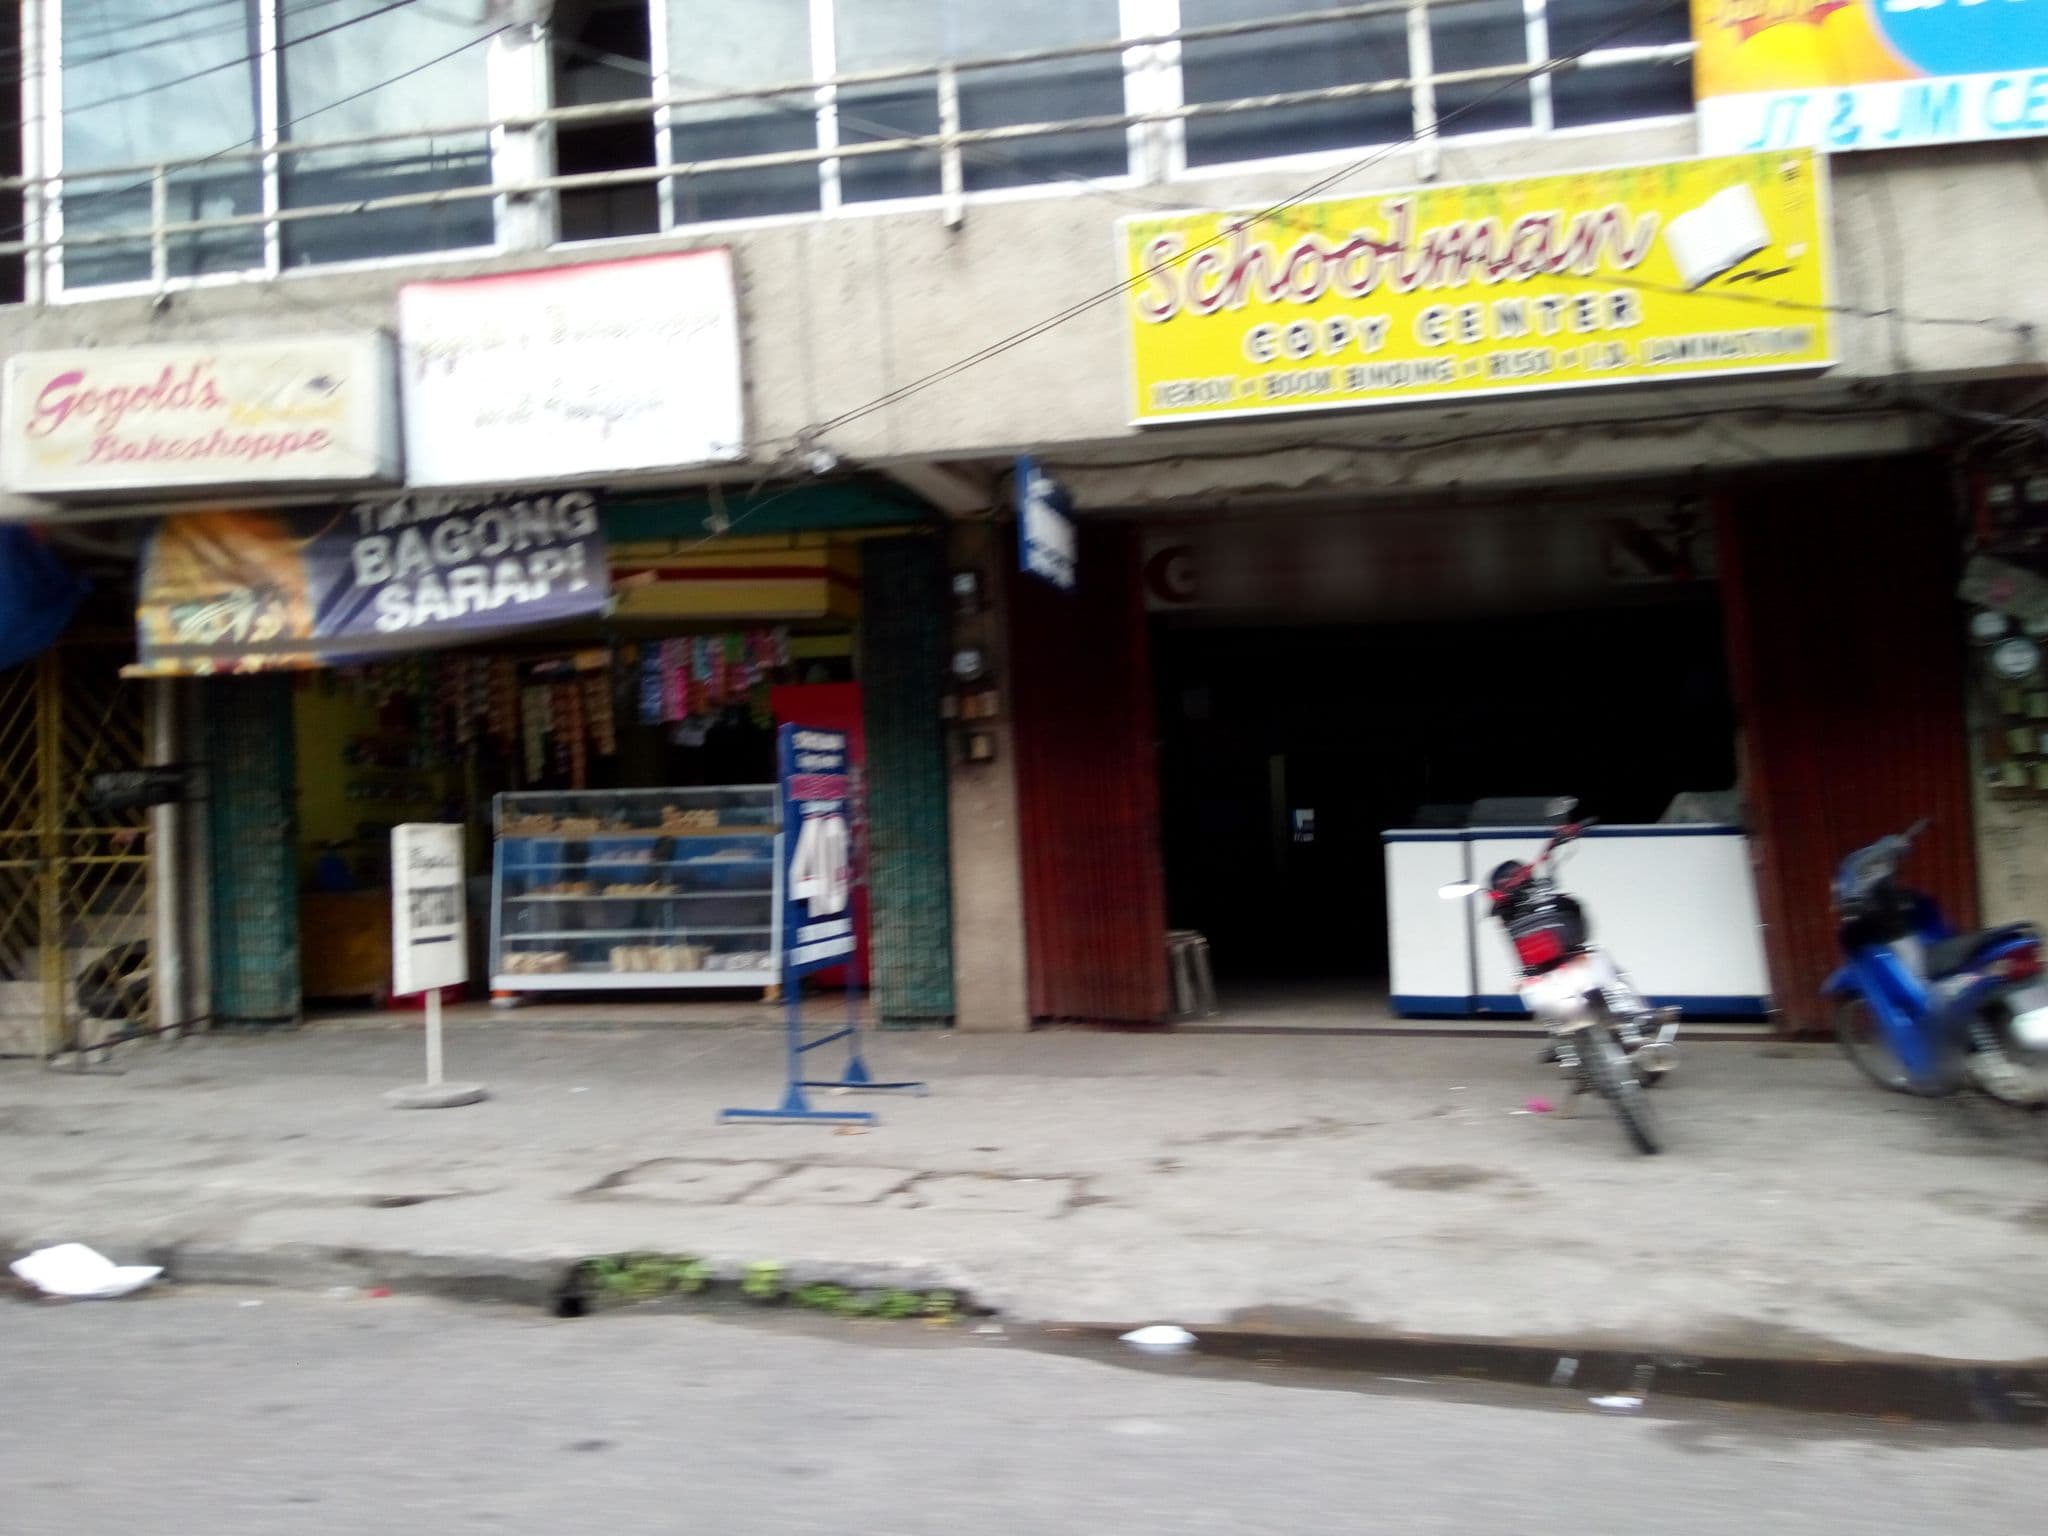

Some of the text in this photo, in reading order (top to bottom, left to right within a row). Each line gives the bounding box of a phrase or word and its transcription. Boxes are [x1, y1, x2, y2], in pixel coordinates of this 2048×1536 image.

[1138, 201, 1659, 324] Schoolman
[1243, 286, 1642, 367] COPY CENTER
[25, 356, 225, 441] Gogold's
[80, 427, 333, 465] Bakeshoppe
[352, 491, 598, 588] BAGONG
[374, 541, 590, 633] SARAP!
